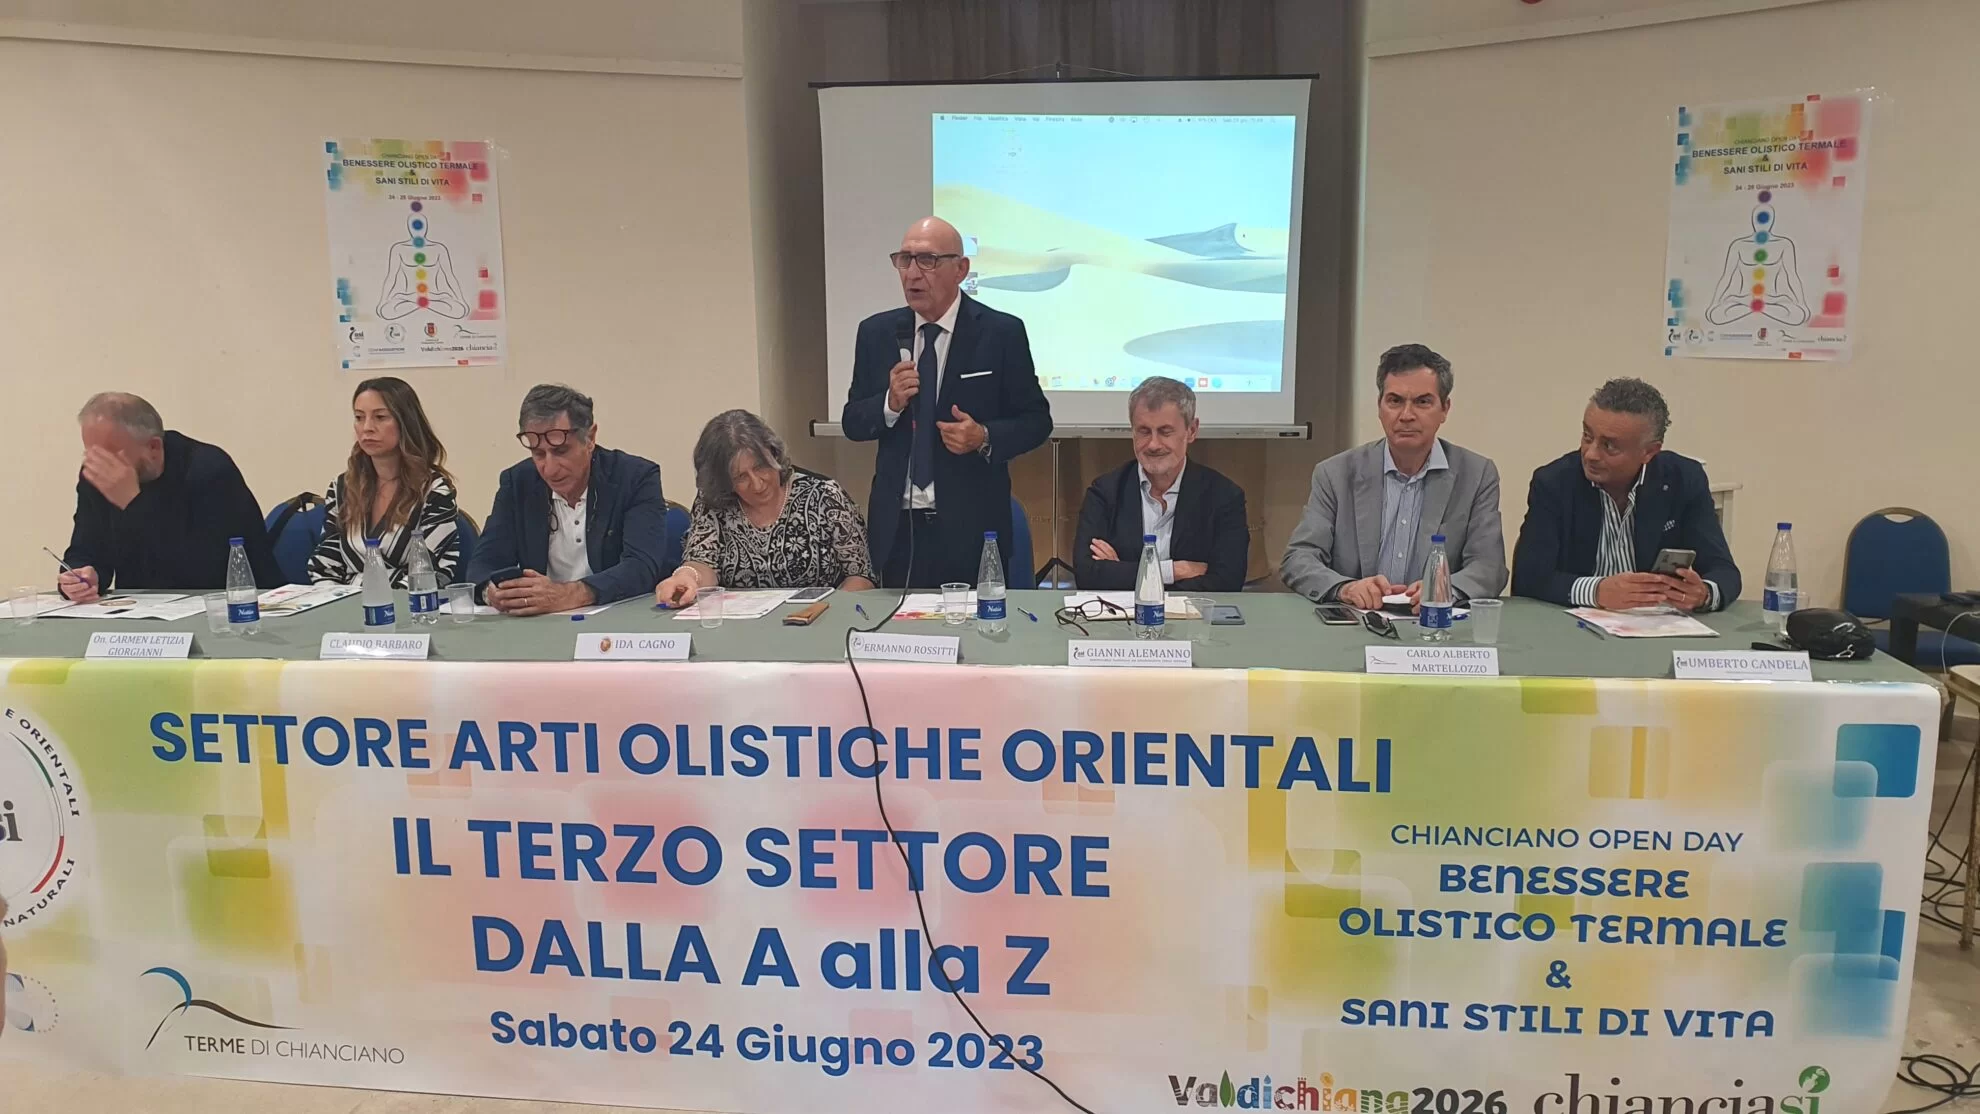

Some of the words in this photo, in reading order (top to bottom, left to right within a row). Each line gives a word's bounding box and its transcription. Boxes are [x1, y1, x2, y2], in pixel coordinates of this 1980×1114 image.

[1692, 147, 1747, 158] BENESSERE
[1750, 144, 1796, 154] OLISTICO
[1799, 139, 1848, 150] TERMALE
[343, 159, 396, 168] BENESSERE
[398, 160, 437, 169] OLISTICO
[439, 162, 479, 170] TERMALE
[1723, 166, 1746, 174] SANI
[1748, 165, 1770, 173] STILI
[1786, 162, 1807, 171] VITA
[94, 636, 107, 644] On.
[109, 636, 150, 644] CARMEN
[150, 636, 185, 644] LETIZIA
[330, 640, 372, 648] CLAUDIO
[376, 640, 422, 649] BARBARO
[615, 640, 634, 649] IDA
[638, 639, 675, 649] CAGNO
[864, 643, 912, 653] ERMANNO
[914, 645, 956, 656] ROSSITTI
[108, 648, 164, 656] GIORGIANNI
[1087, 648, 1125, 657] GIANNI
[1128, 649, 1191, 658] ALEMANNO
[1407, 650, 1440, 658] CARLO
[1442, 650, 1490, 659] ALBERTO
[1412, 664, 1487, 673] MARTELLOZZO
[1688, 657, 1748, 668] UMBERTO
[1751, 659, 1808, 670] CANDELA
[149, 711, 430, 768] SETTORE
[448, 719, 599, 774] ARTI
[618, 722, 982, 781] OLISTICHE
[1001, 728, 1392, 793] ORIENTALI
[5, 708, 15, 719] E
[20, 719, 80, 817] ORIENTALI
[1391, 824, 1580, 848] CHIANCIANO
[1589, 829, 1672, 852] OPEN
[1683, 831, 1744, 853] DAY
[392, 816, 452, 876] IL
[467, 819, 723, 886] TERZO
[745, 826, 1110, 898] SETTORE
[3, 858, 75, 927] NATURALI
[1338, 907, 1556, 942] OLISTICO
[1569, 913, 1789, 947] TERMALE
[471, 915, 722, 985] DALLA
[741, 928, 800, 988] A
[820, 928, 980, 994] alla
[1005, 935, 1051, 996] Z
[1545, 959, 1572, 989] &
[1340, 998, 1450, 1030] SANI
[1462, 1003, 1584, 1035] STILI
[1598, 1008, 1650, 1038] DI
[1663, 1008, 1775, 1039] VITA
[184, 1035, 246, 1054] TERME
[251, 1039, 270, 1056] DI
[275, 1040, 405, 1065] CHIANCIANO
[490, 1010, 657, 1054] Sabato
[668, 1020, 725, 1059] 24
[736, 1023, 916, 1077] Giugno
[927, 1031, 1044, 1072] 2023
